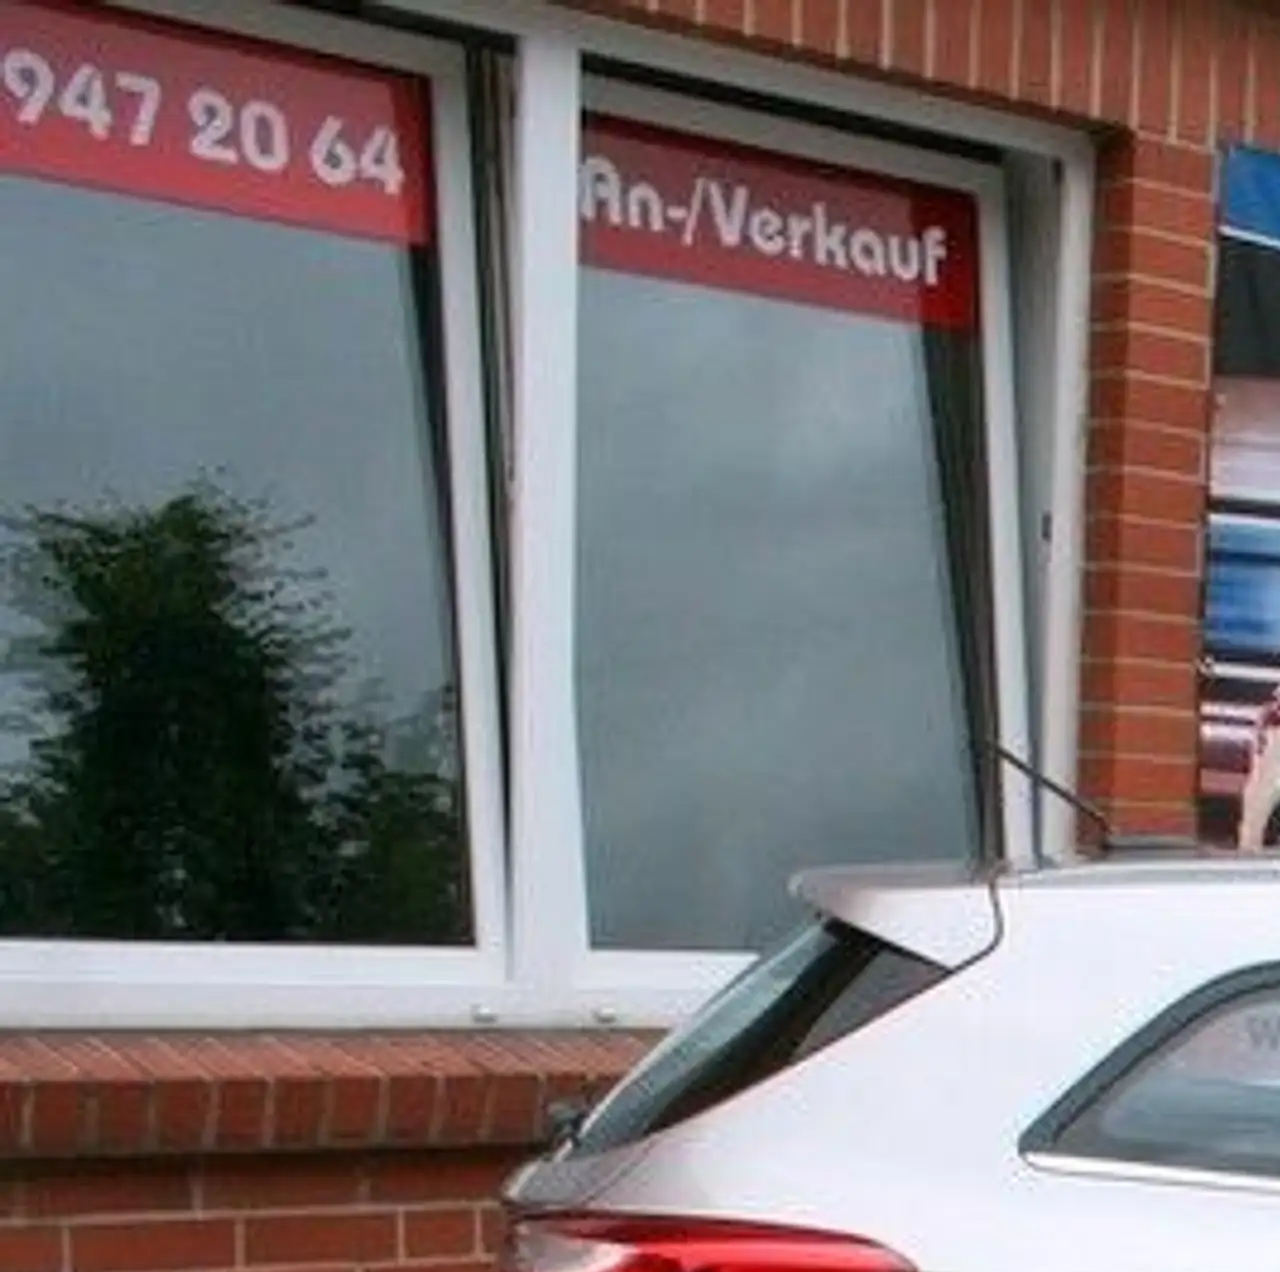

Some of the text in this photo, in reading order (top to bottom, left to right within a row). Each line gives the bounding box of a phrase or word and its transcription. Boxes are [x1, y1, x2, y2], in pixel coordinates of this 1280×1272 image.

[3, 47, 405, 196] 947 20 64
[578, 156, 948, 286] An-/Verkauf
